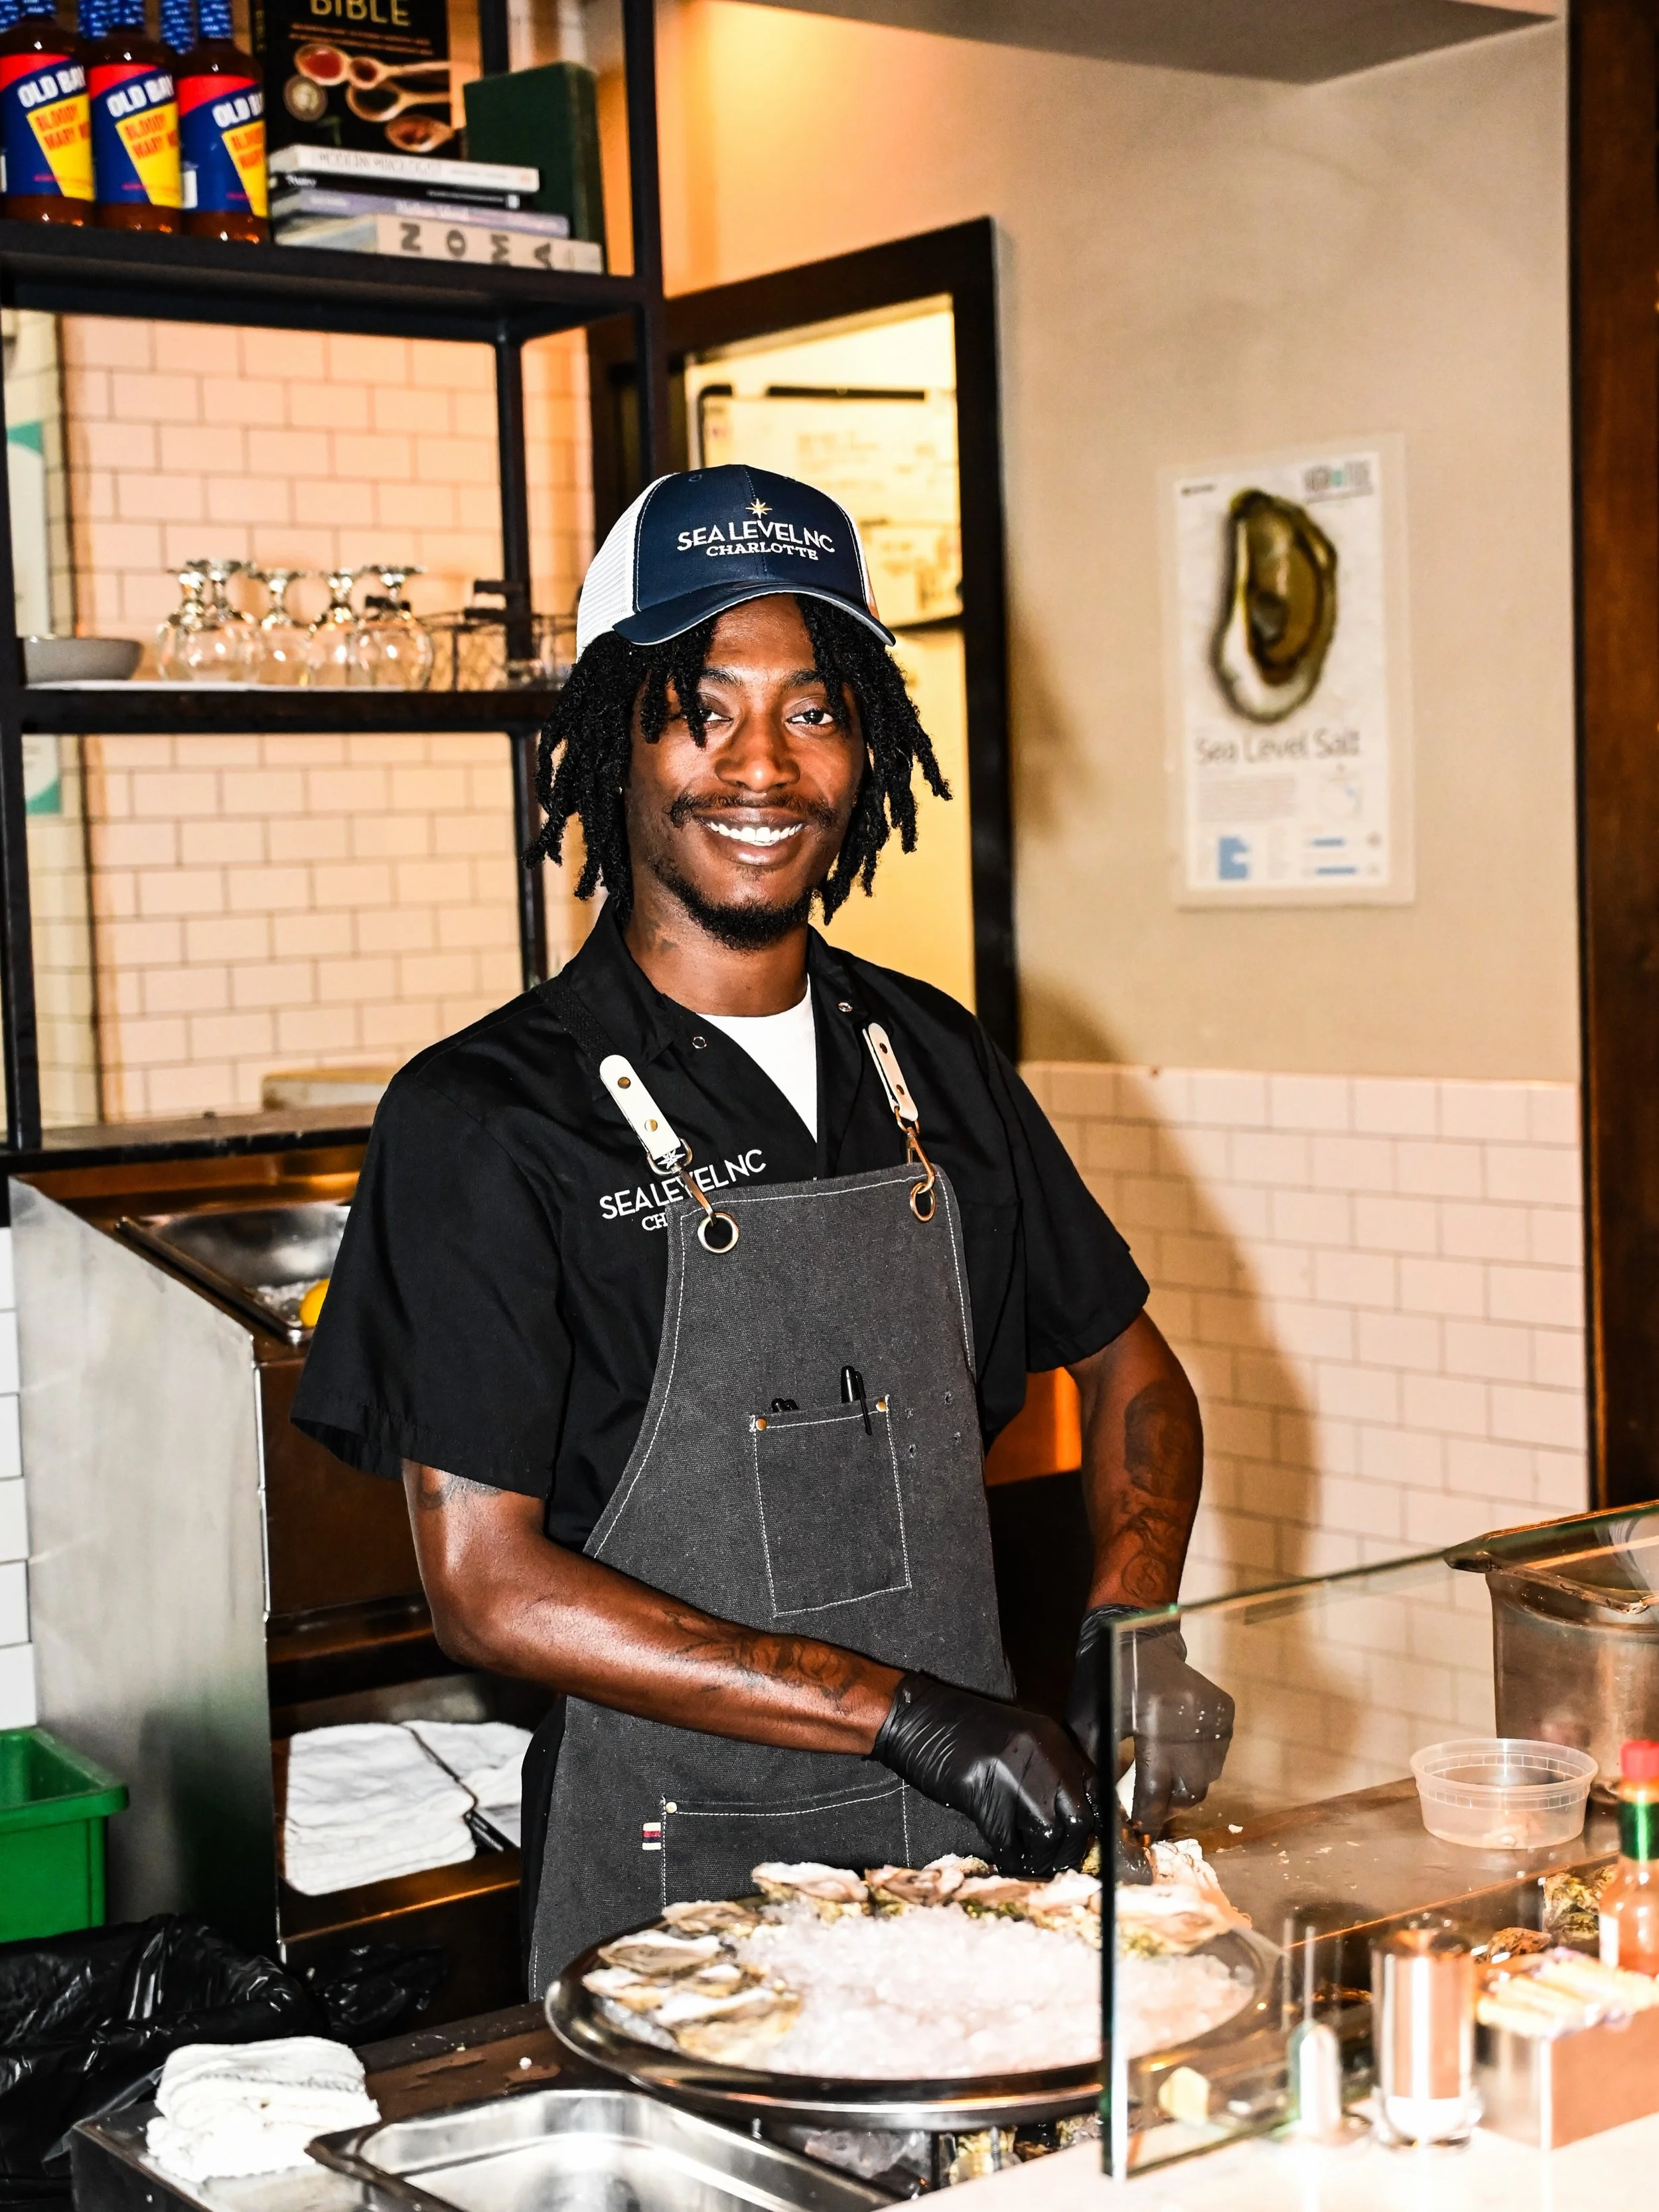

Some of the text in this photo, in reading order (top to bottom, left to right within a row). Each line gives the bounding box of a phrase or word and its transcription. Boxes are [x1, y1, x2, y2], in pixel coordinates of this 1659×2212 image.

[311, 0, 411, 26] BIBLE
[17, 74, 58, 108] OLD
[106, 84, 147, 117] OLD
[212, 98, 251, 127] OLD
[401, 222, 553, 269] NOMA
[677, 520, 835, 553] SEA LEVEL NC
[706, 541, 819, 561] CHARLOTTE
[1193, 735, 1240, 765] Sea
[1243, 729, 1309, 763] Level
[599, 1187, 654, 1219] SEA
[724, 1149, 766, 1182] NC
